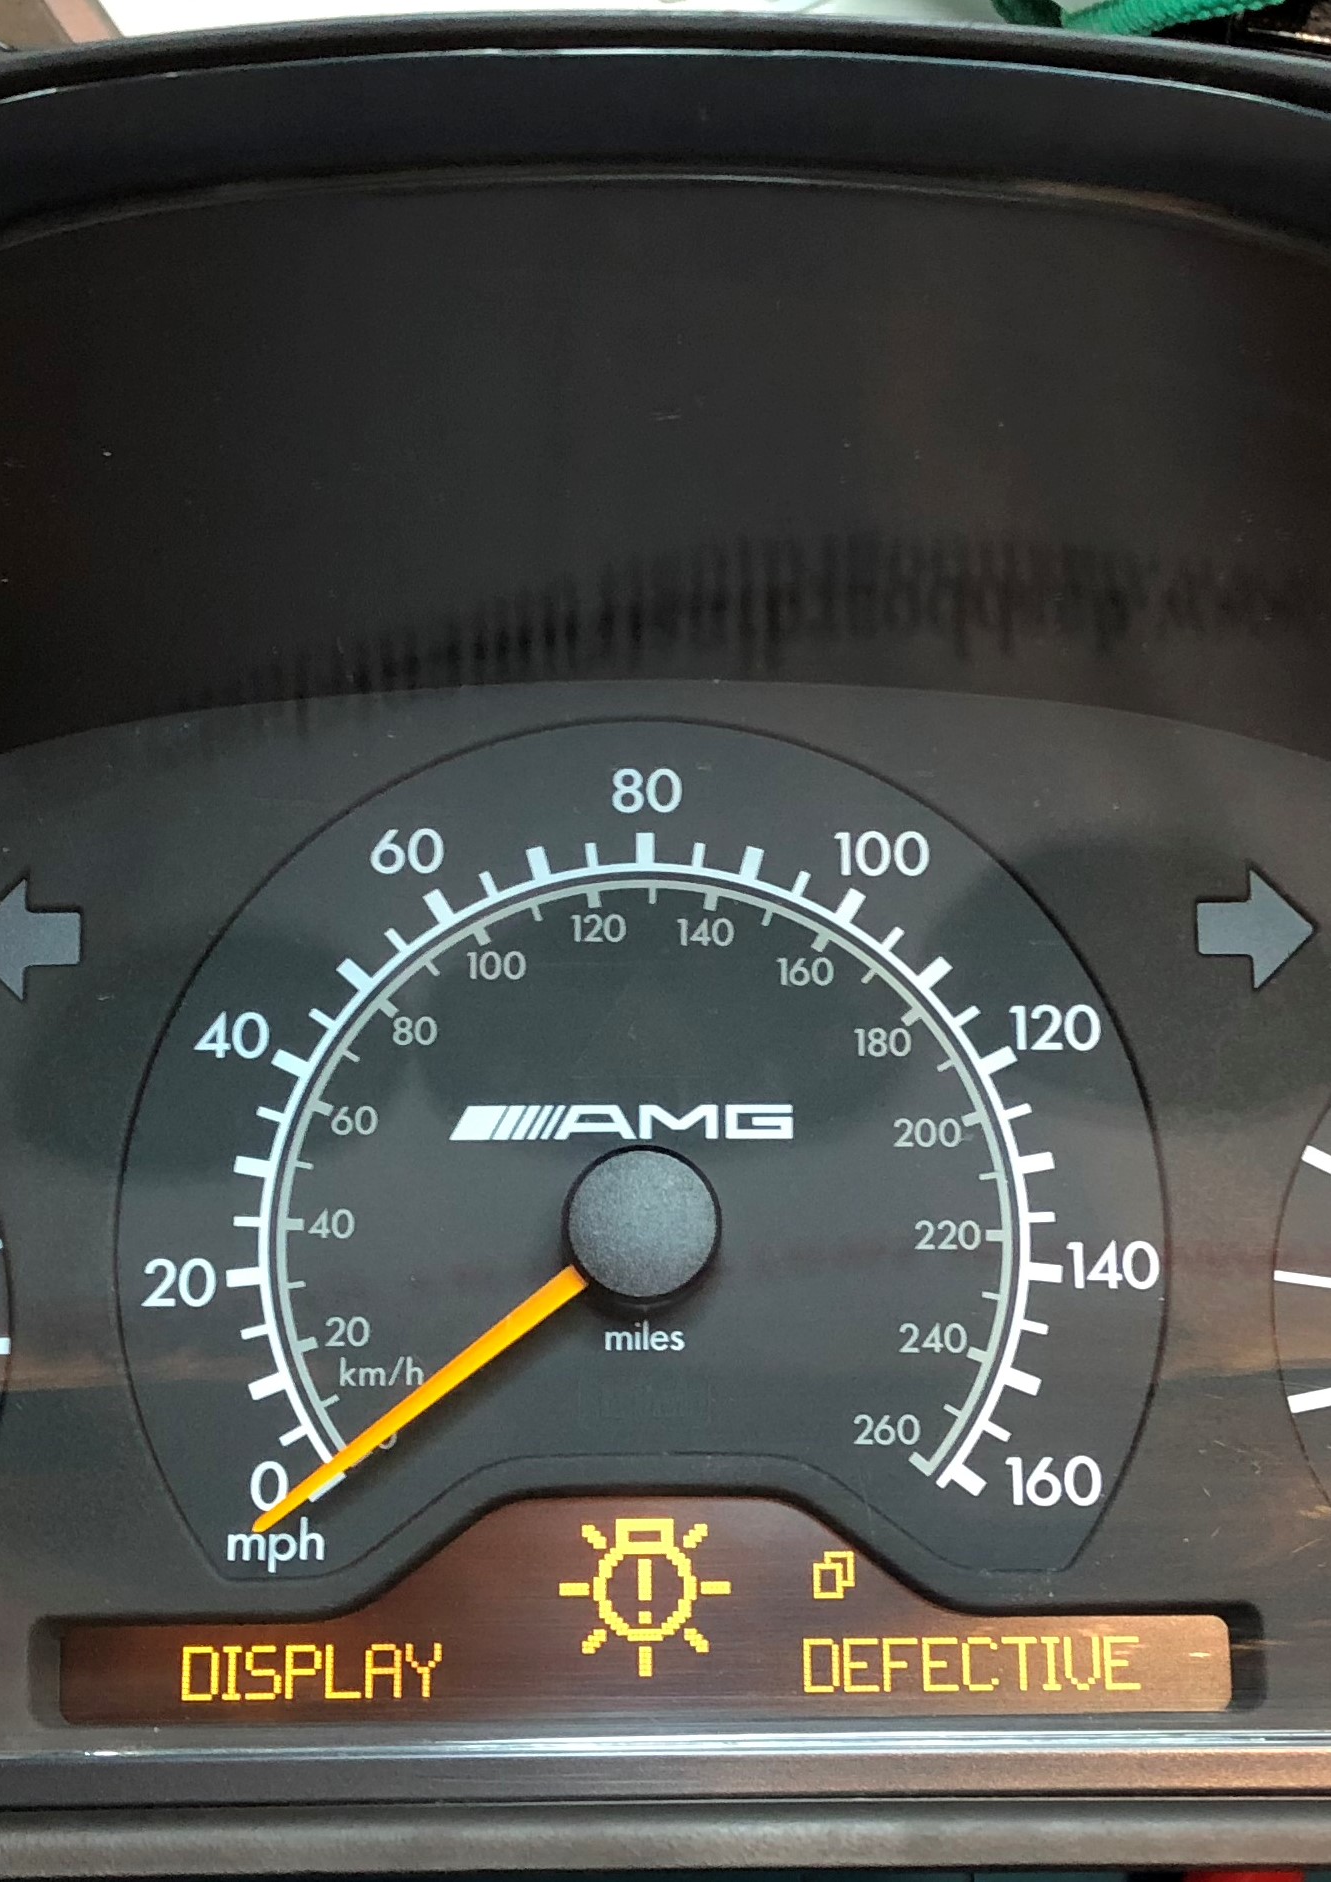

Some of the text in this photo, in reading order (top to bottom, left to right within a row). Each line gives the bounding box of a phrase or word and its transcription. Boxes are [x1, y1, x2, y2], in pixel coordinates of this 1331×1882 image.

[613, 769, 682, 813] 80
[371, 828, 443, 874] 60
[834, 831, 929, 876] 100
[571, 914, 626, 942] 120
[677, 918, 734, 946] 140
[467, 951, 526, 980] 100
[777, 957, 833, 986] 160
[194, 1012, 269, 1058] 40
[393, 1017, 437, 1045] 80
[854, 1028, 911, 1057] 180
[1008, 1004, 1101, 1051] 120
[330, 1106, 377, 1135] 60
[554, 1105, 794, 1139] AMG
[894, 1118, 962, 1147] 200
[308, 1209, 354, 1238] 40
[915, 1220, 981, 1250] 220
[1067, 1240, 1159, 1289] 140
[142, 1258, 216, 1307] 20
[326, 1317, 369, 1346] 20
[605, 1322, 685, 1350] miles
[900, 1323, 967, 1353] 240
[340, 1357, 424, 1386] km/h
[854, 1414, 920, 1445] 260
[251, 1461, 288, 1511] 0
[1006, 1456, 1101, 1506] 160
[228, 1517, 324, 1573] mph
[181, 1636, 1141, 1702] DISPLAY DEFECTIVE
